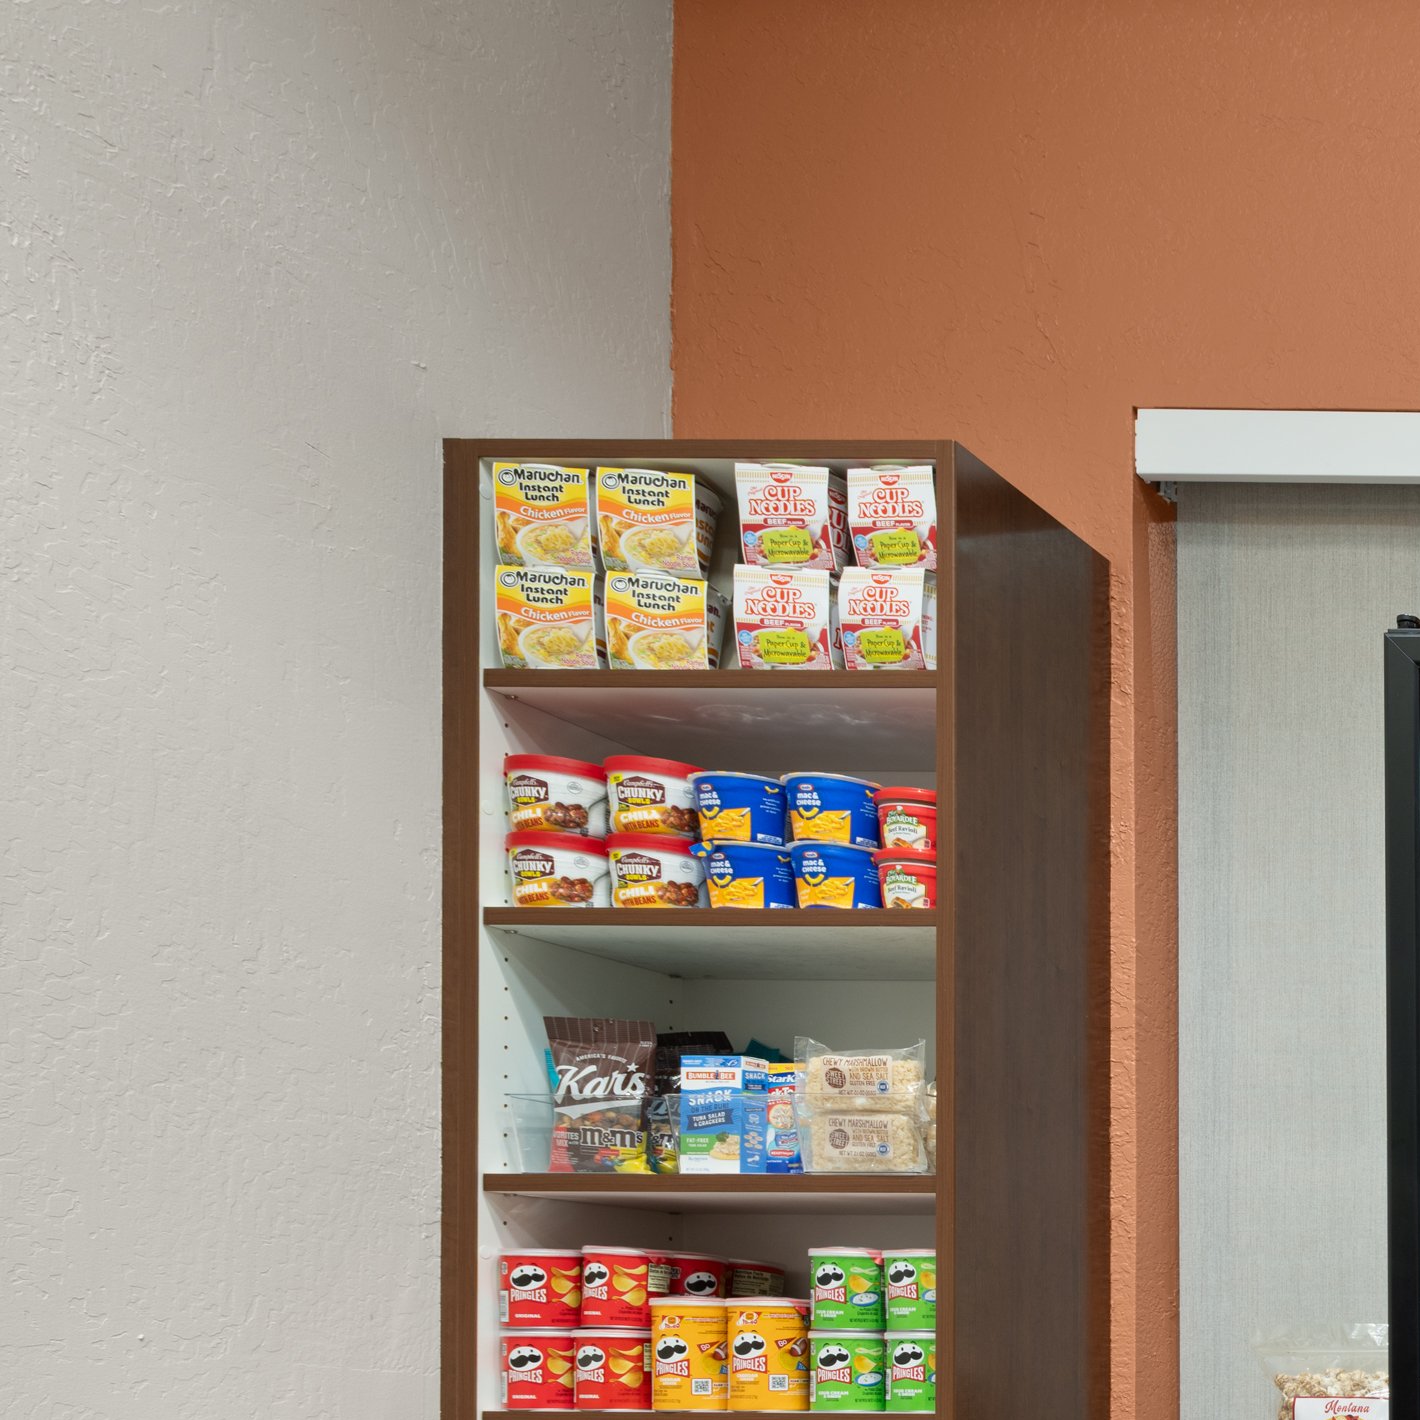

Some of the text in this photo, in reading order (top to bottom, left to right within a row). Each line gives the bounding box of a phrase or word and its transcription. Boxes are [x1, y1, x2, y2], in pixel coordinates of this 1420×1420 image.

[514, 469, 581, 484] Maruchan
[519, 481, 564, 494] Instant
[525, 491, 560, 502] Lunch
[520, 505, 586, 518] Chicken Flavor
[763, 587, 800, 602] CUP
[746, 601, 815, 618] NOODLES
[617, 862, 659, 876] CHUNKY
[555, 1064, 645, 1102] Kar's
[708, 1112, 725, 1120] SALAD
[848, 1119, 888, 1128] MARSHMALLOW
[509, 1289, 547, 1303] PRINGLES
